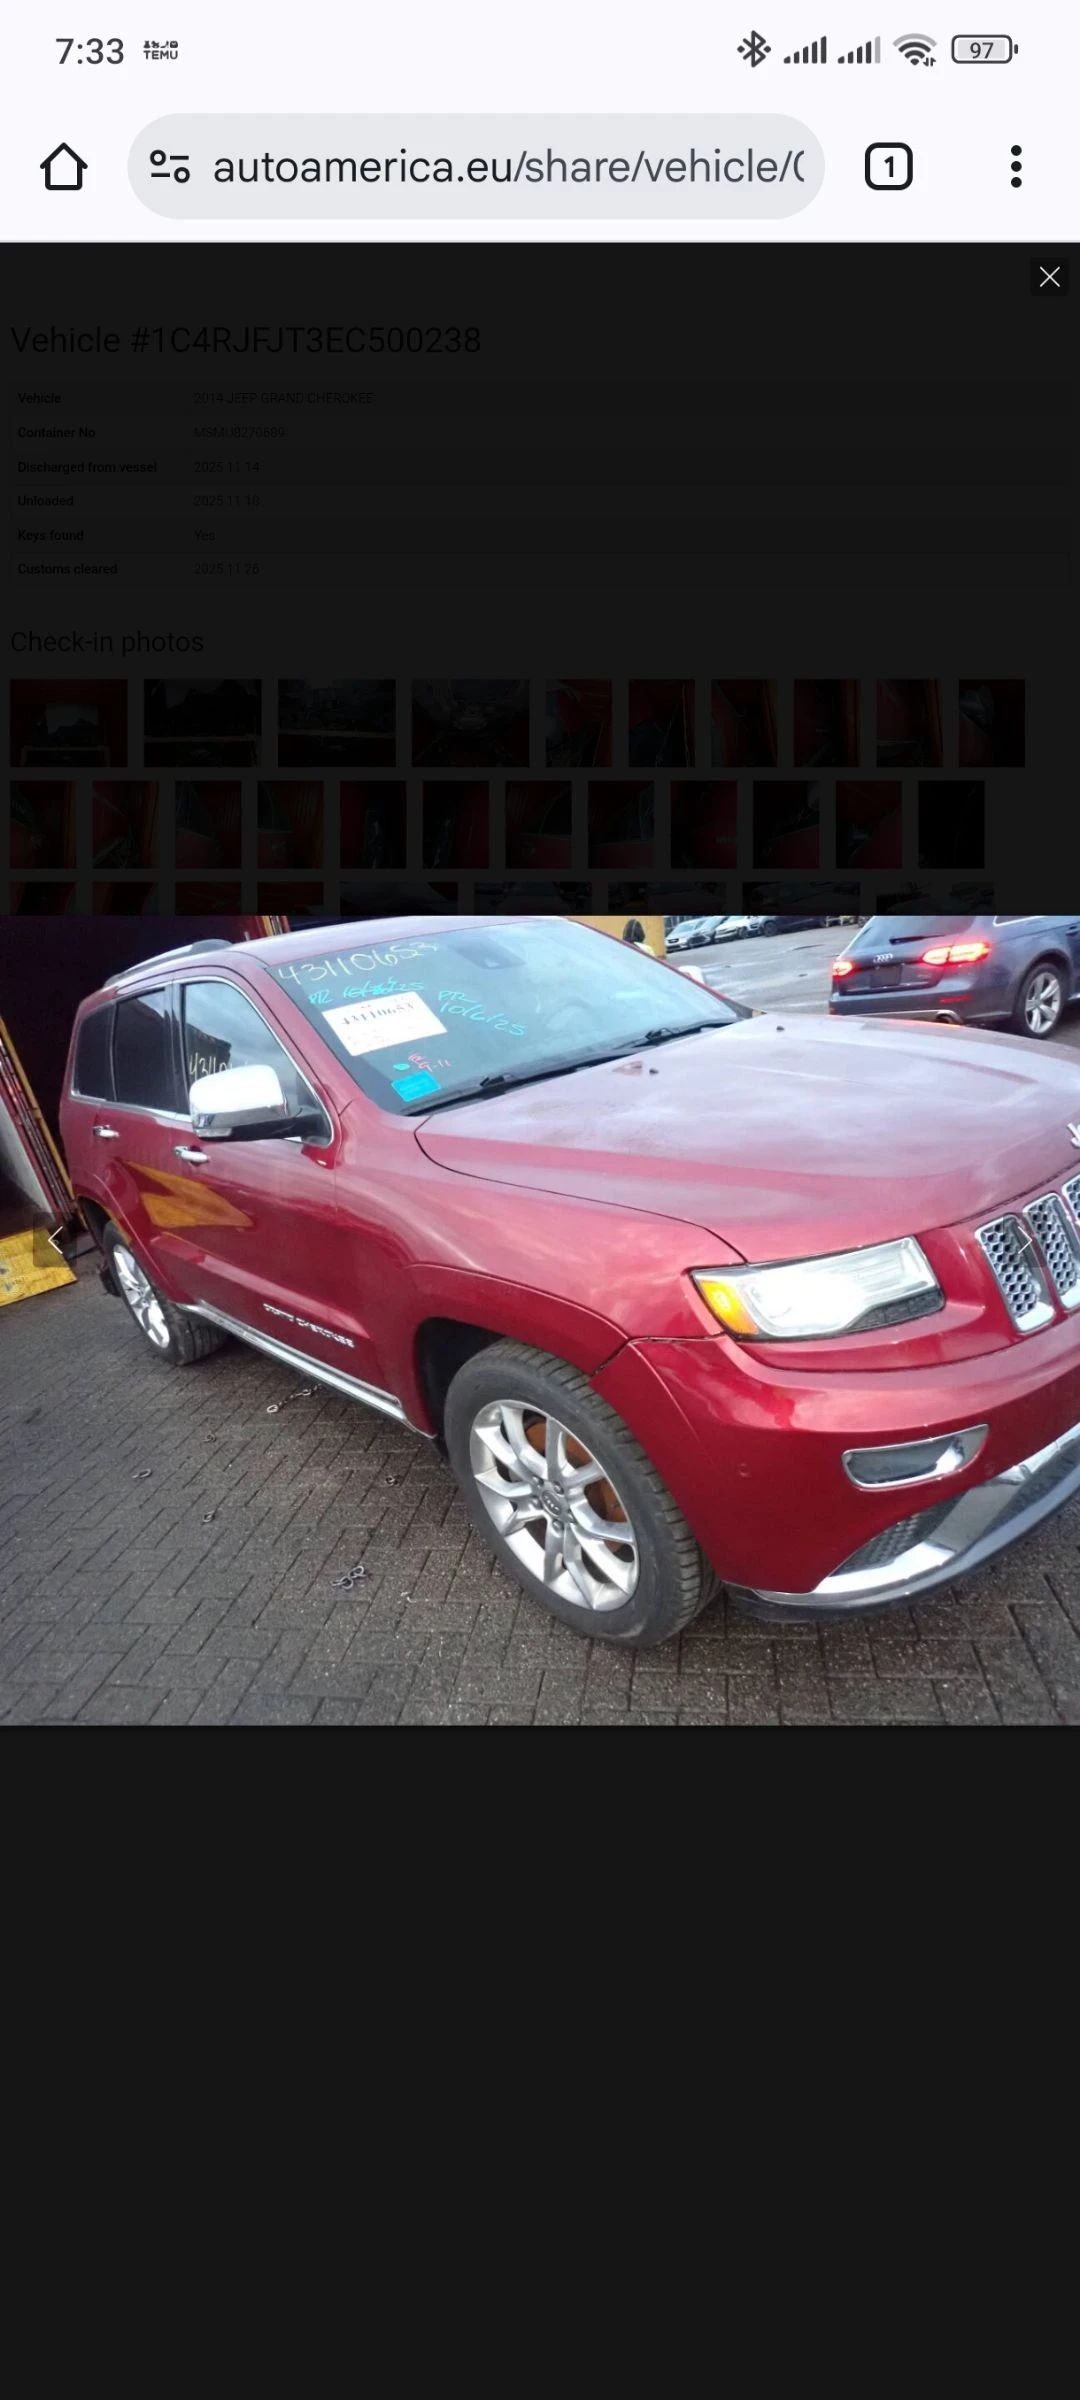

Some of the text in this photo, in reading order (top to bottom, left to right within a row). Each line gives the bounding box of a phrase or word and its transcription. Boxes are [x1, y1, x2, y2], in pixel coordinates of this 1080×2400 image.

[56, 37, 125, 65] 7:33
[143, 50, 179, 60] TEMU
[969, 42, 995, 59] 97
[883, 155, 895, 178] 1
[10, 326, 481, 353] Vehicle #1C4RJFJT3EC500238
[17, 426, 96, 439] Container No
[17, 460, 158, 476] Discharged from vessel
[17, 528, 85, 544] Keys found
[17, 563, 118, 576] Customs cleared
[10, 628, 205, 659] Check-in photos
